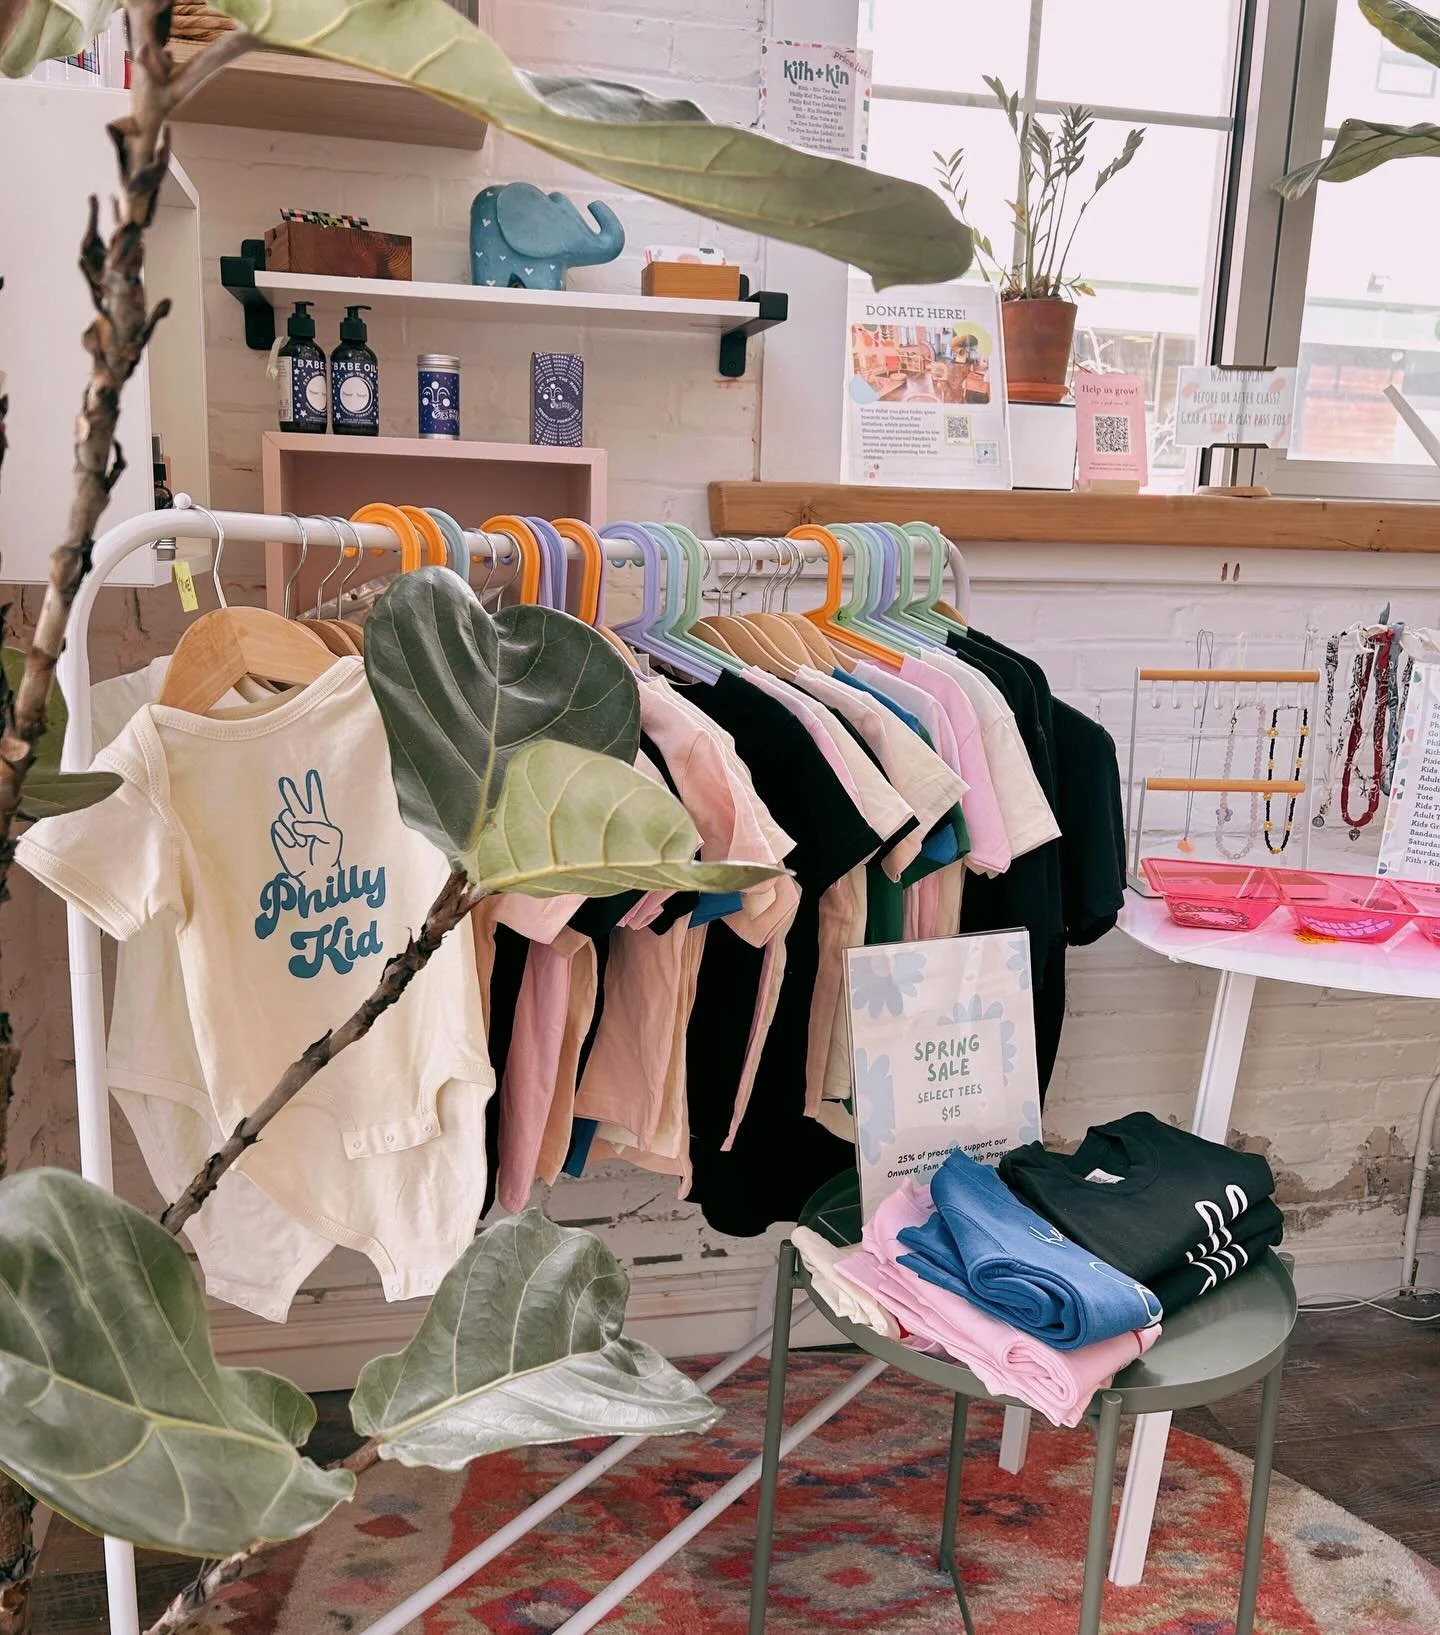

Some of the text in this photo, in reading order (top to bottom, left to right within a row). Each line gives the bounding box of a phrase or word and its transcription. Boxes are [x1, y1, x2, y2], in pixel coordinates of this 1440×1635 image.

[834, 51, 854, 67] price
[784, 60, 813, 84] kith
[826, 64, 849, 88] kin
[866, 306, 967, 320] DONATE HERE!
[334, 362, 376, 373] BABE OIL
[1082, 384, 1101, 396] Help
[1115, 387, 1138, 397] grow!
[1194, 392, 1280, 404] BEFORE OR AFTER CLASS?
[1181, 412, 1200, 424] GRAB
[1210, 413, 1226, 424] STAY
[1236, 413, 1251, 425] PLAY
[1255, 414, 1270, 426] PASS
[1420, 775, 1440, 783] Adult
[1413, 811, 1434, 819] Adult
[1406, 856, 1422, 864] Kith
[255, 865, 386, 940] Philly
[288, 916, 384, 978] Kid
[914, 1034, 980, 1062] SPRING
[928, 1058, 970, 1082] SALE
[918, 1084, 982, 1104] SELECT TEES
[942, 1104, 961, 1122] $15
[898, 1154, 915, 1163] 25%
[918, 1151, 925, 1160] of
[928, 1146, 961, 1160] procee
[964, 1140, 992, 1151] support
[888, 1165, 920, 1178] Onward,
[986, 1151, 1008, 1159] Progr
